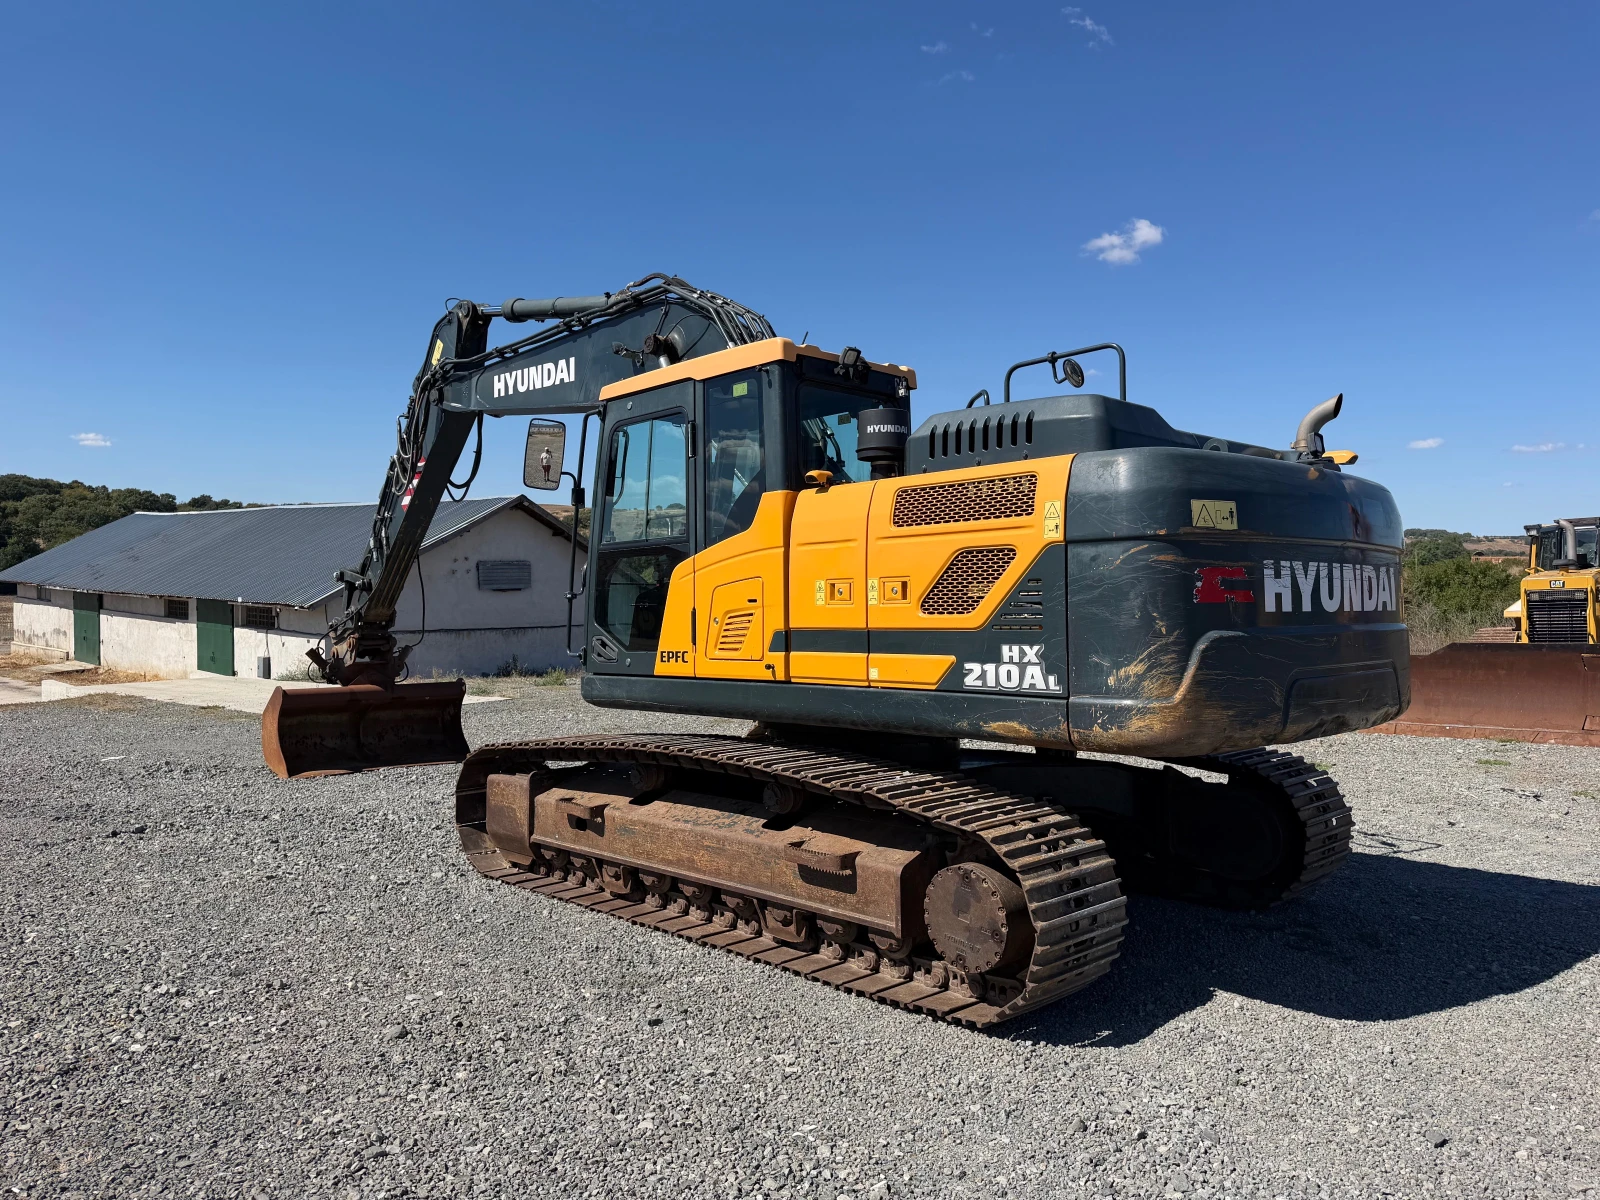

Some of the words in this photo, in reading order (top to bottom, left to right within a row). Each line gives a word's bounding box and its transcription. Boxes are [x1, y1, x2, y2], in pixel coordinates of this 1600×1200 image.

[493, 356, 576, 398] HYUNDAI
[866, 424, 908, 434] HYUNDAI
[1263, 559, 1397, 613] HYUNDAI
[1550, 580, 1564, 588] CAT
[660, 650, 689, 664] EPFC
[1001, 644, 1042, 664] HX
